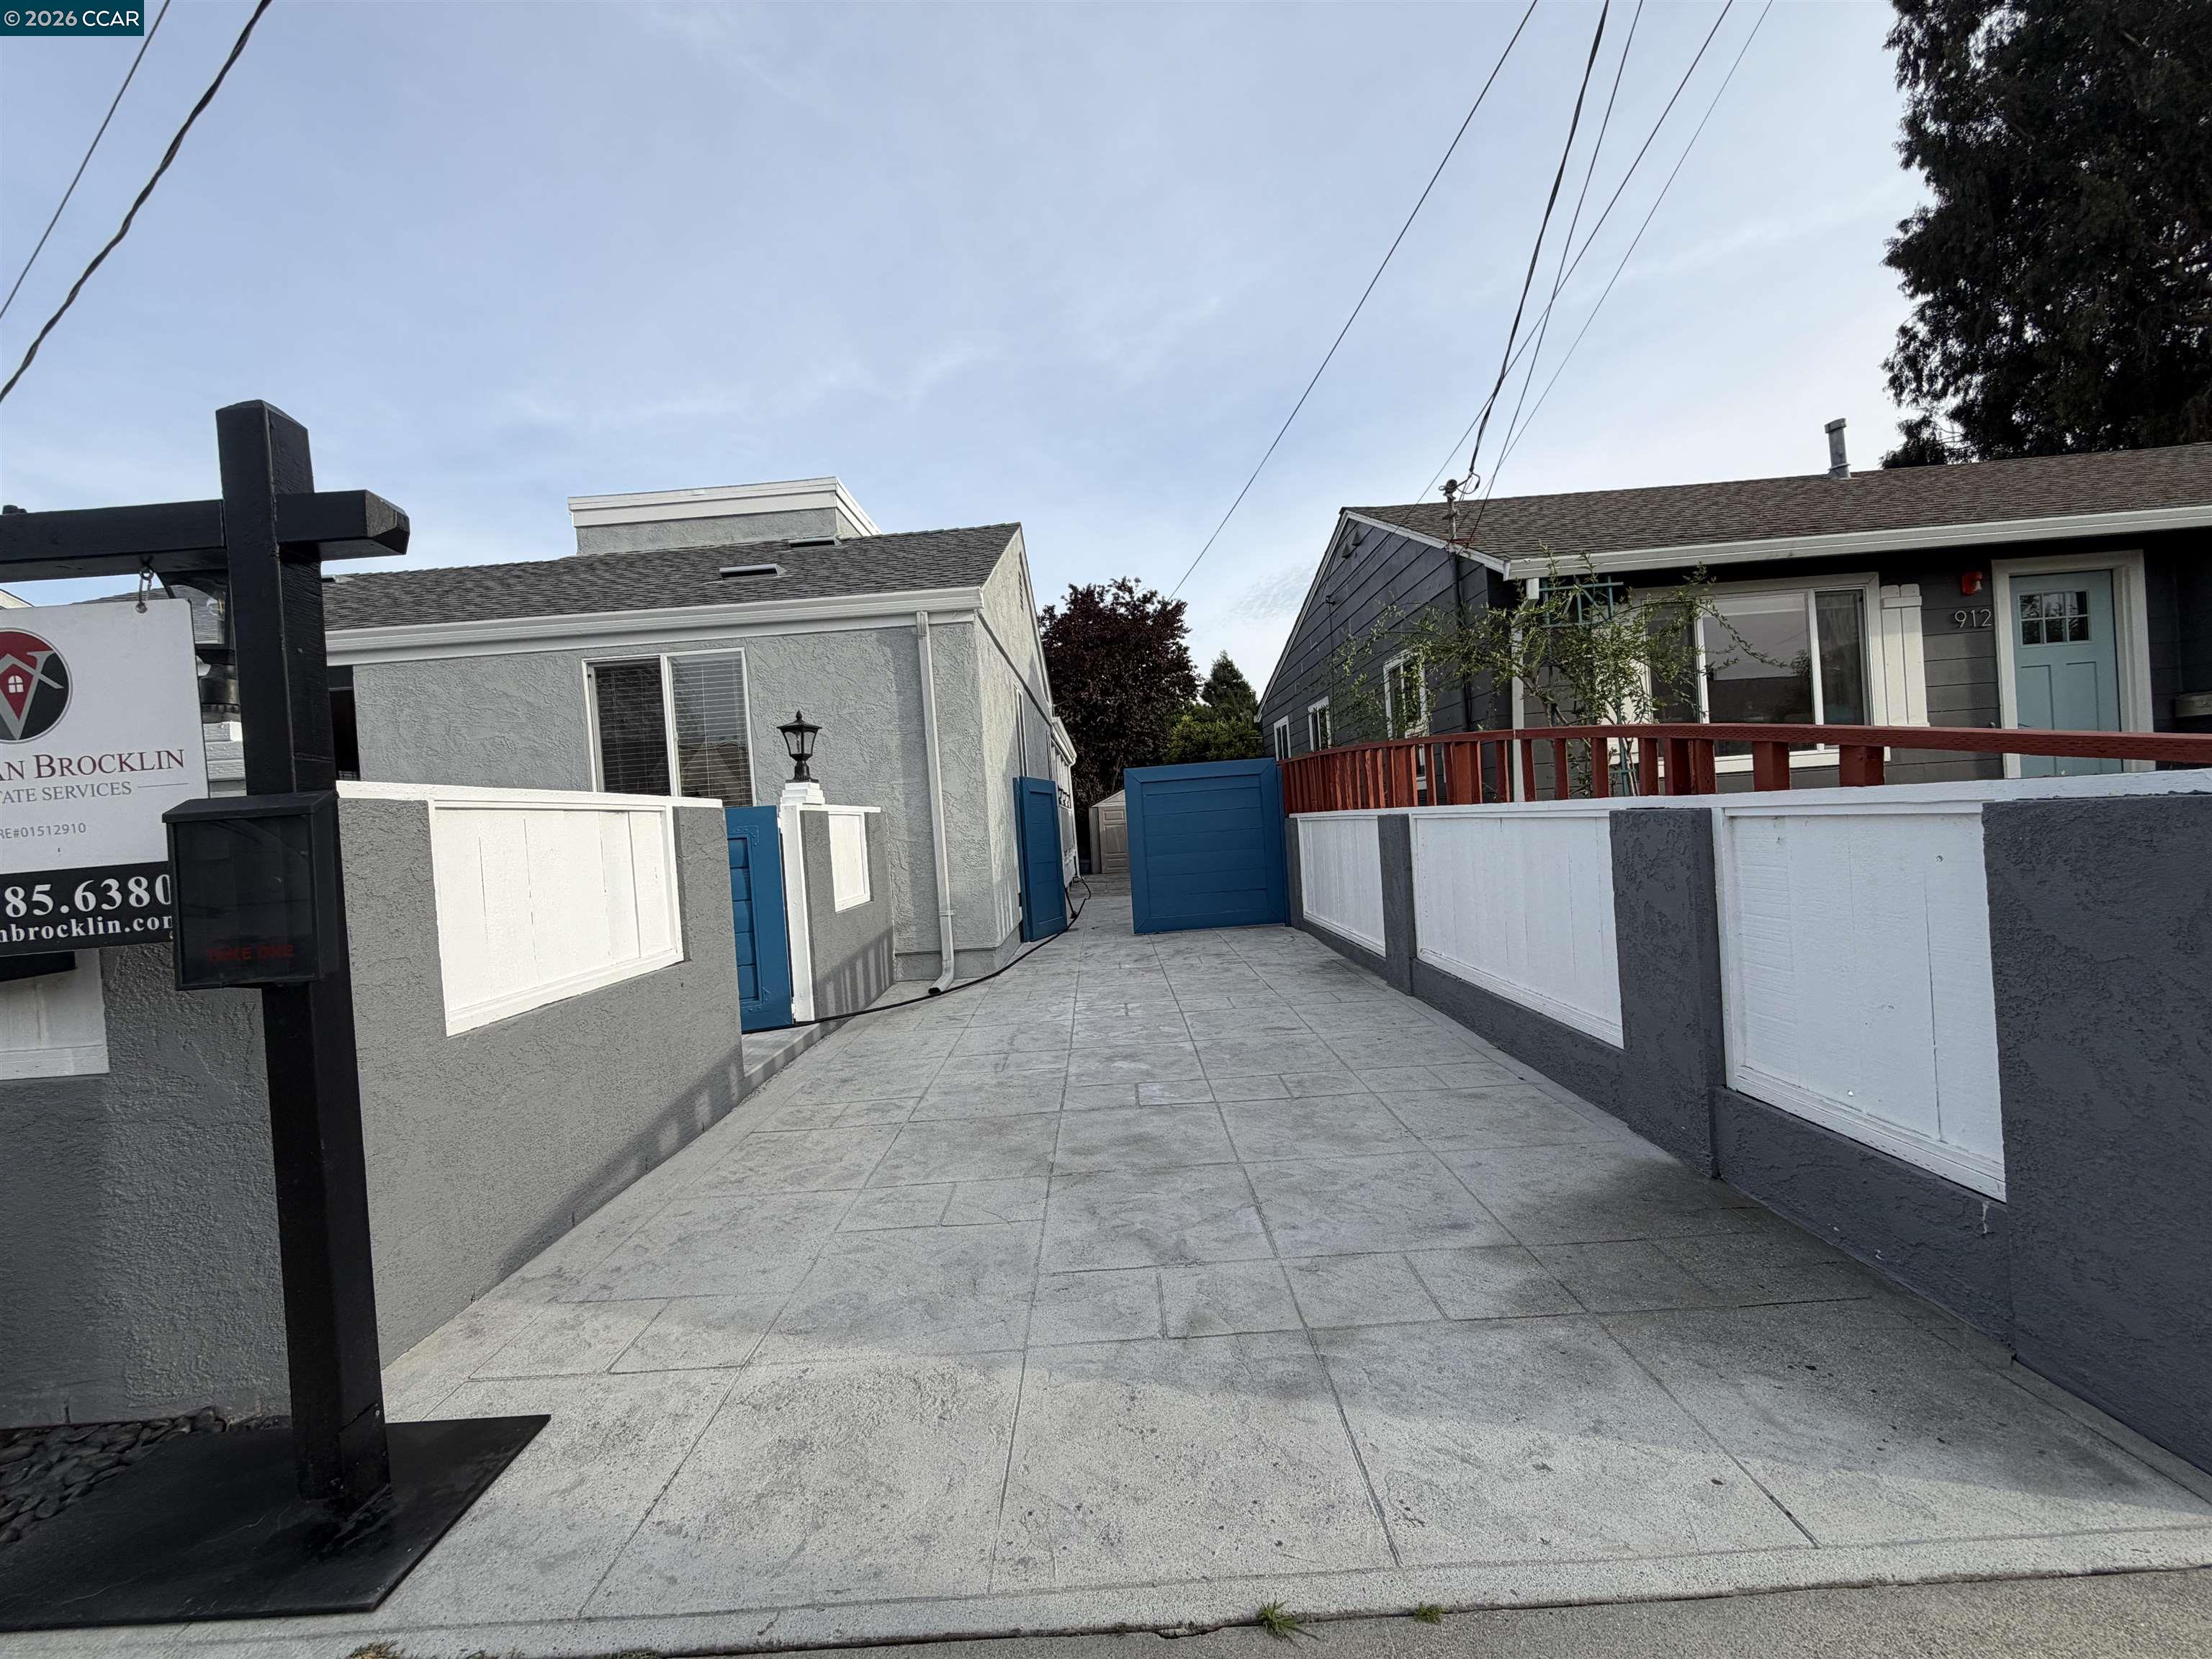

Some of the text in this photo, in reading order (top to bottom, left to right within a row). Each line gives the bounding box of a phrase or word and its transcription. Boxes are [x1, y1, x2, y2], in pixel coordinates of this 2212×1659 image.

[1954, 608, 1992, 629] 912
[32, 749, 184, 779] BROCKLIN
[41, 781, 132, 801] SERVICES
